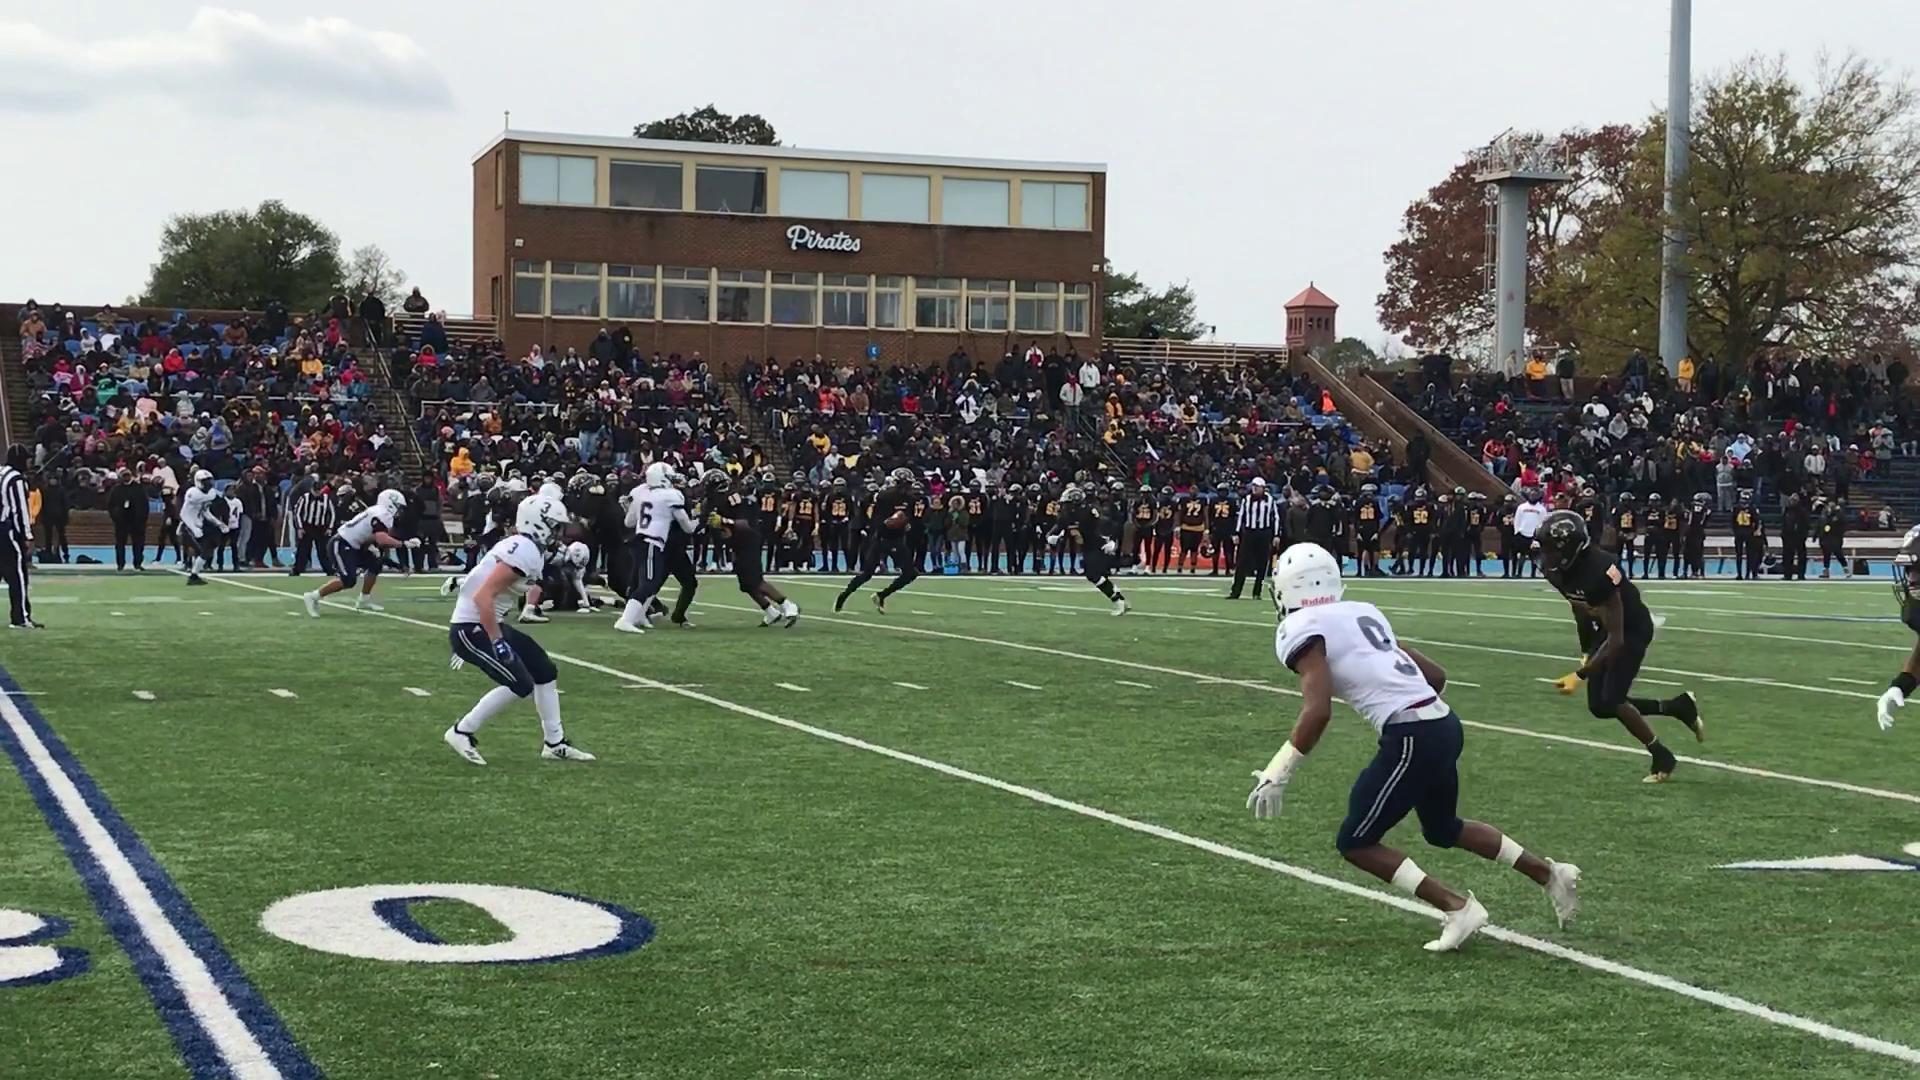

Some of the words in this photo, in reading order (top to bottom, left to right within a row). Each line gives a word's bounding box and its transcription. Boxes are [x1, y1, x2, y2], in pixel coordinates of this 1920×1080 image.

[786, 225, 861, 252] Pirates
[540, 501, 552, 514] 3
[640, 501, 653, 529] 6
[507, 542, 519, 554] 3
[1356, 615, 1418, 676] 9
